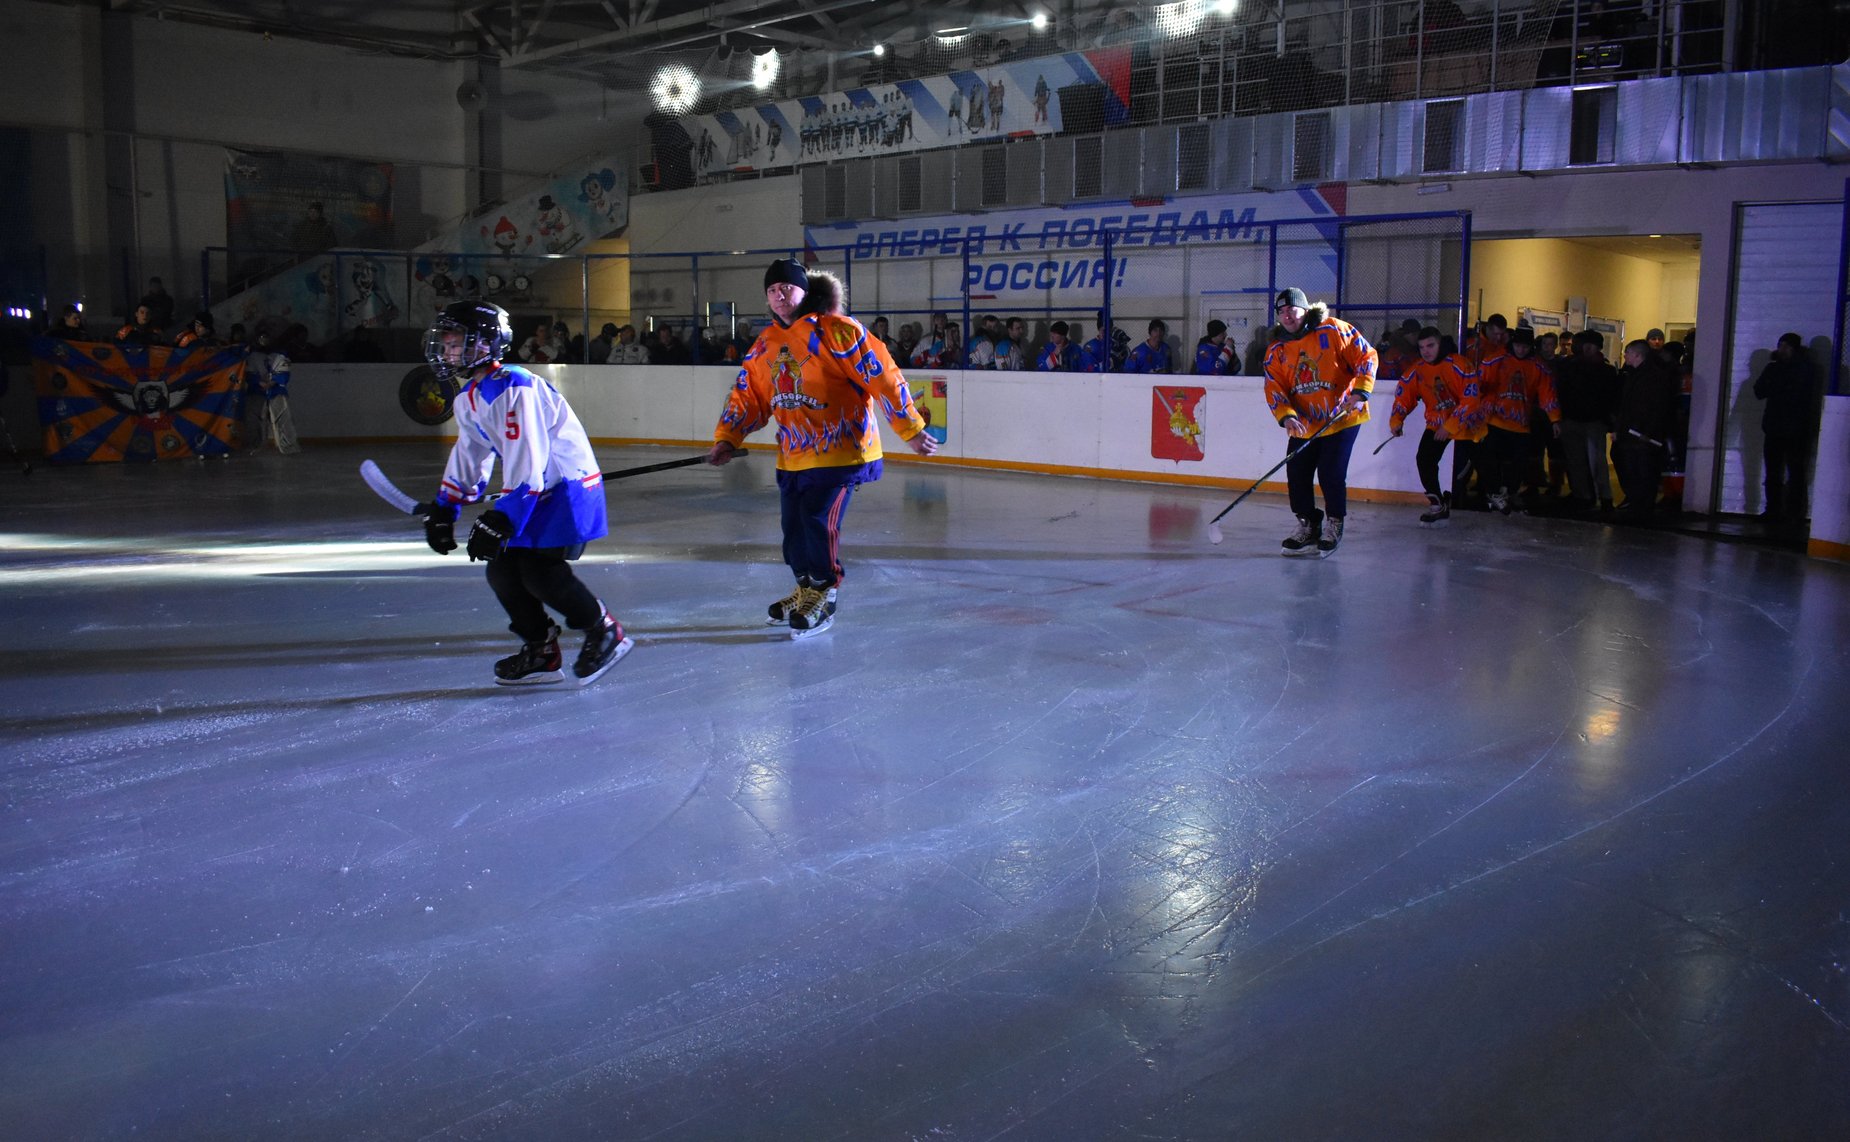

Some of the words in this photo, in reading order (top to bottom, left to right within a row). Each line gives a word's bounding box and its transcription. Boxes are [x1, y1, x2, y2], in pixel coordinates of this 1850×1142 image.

[854, 225, 987, 258] ВПЕРЕД
[999, 222, 1025, 251] К
[1039, 207, 1264, 248] ПОБЕДАМ,
[960, 257, 1128, 292] РОССИЯ!
[505, 411, 520, 440] 5
